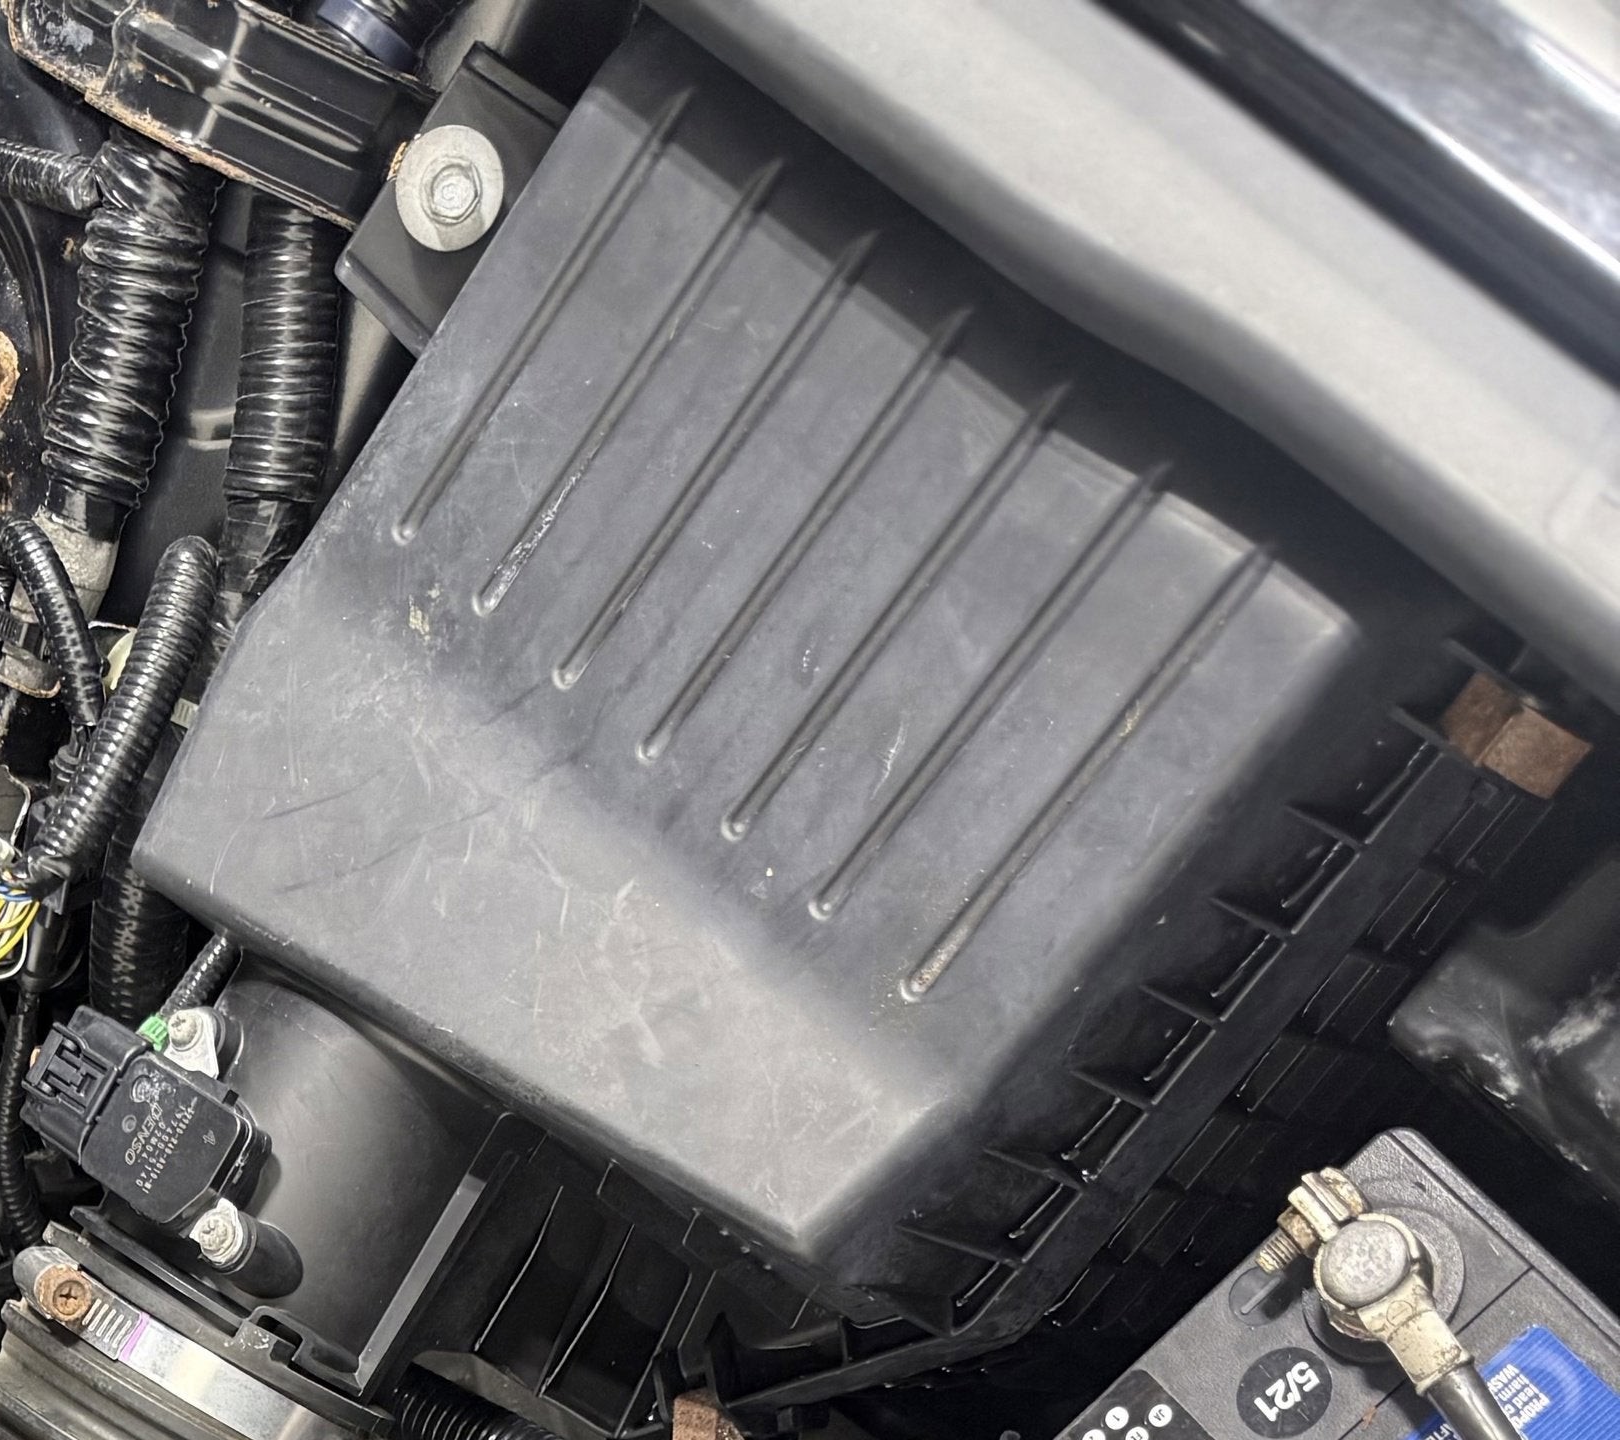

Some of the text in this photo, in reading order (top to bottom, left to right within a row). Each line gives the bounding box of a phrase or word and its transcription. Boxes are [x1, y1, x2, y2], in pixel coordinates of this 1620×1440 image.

[122, 1101, 164, 1165] DENSO
[1252, 1357, 1323, 1424] 5/21
[1513, 1383, 1537, 1406] lead
[1152, 1408, 1166, 1422] JA
